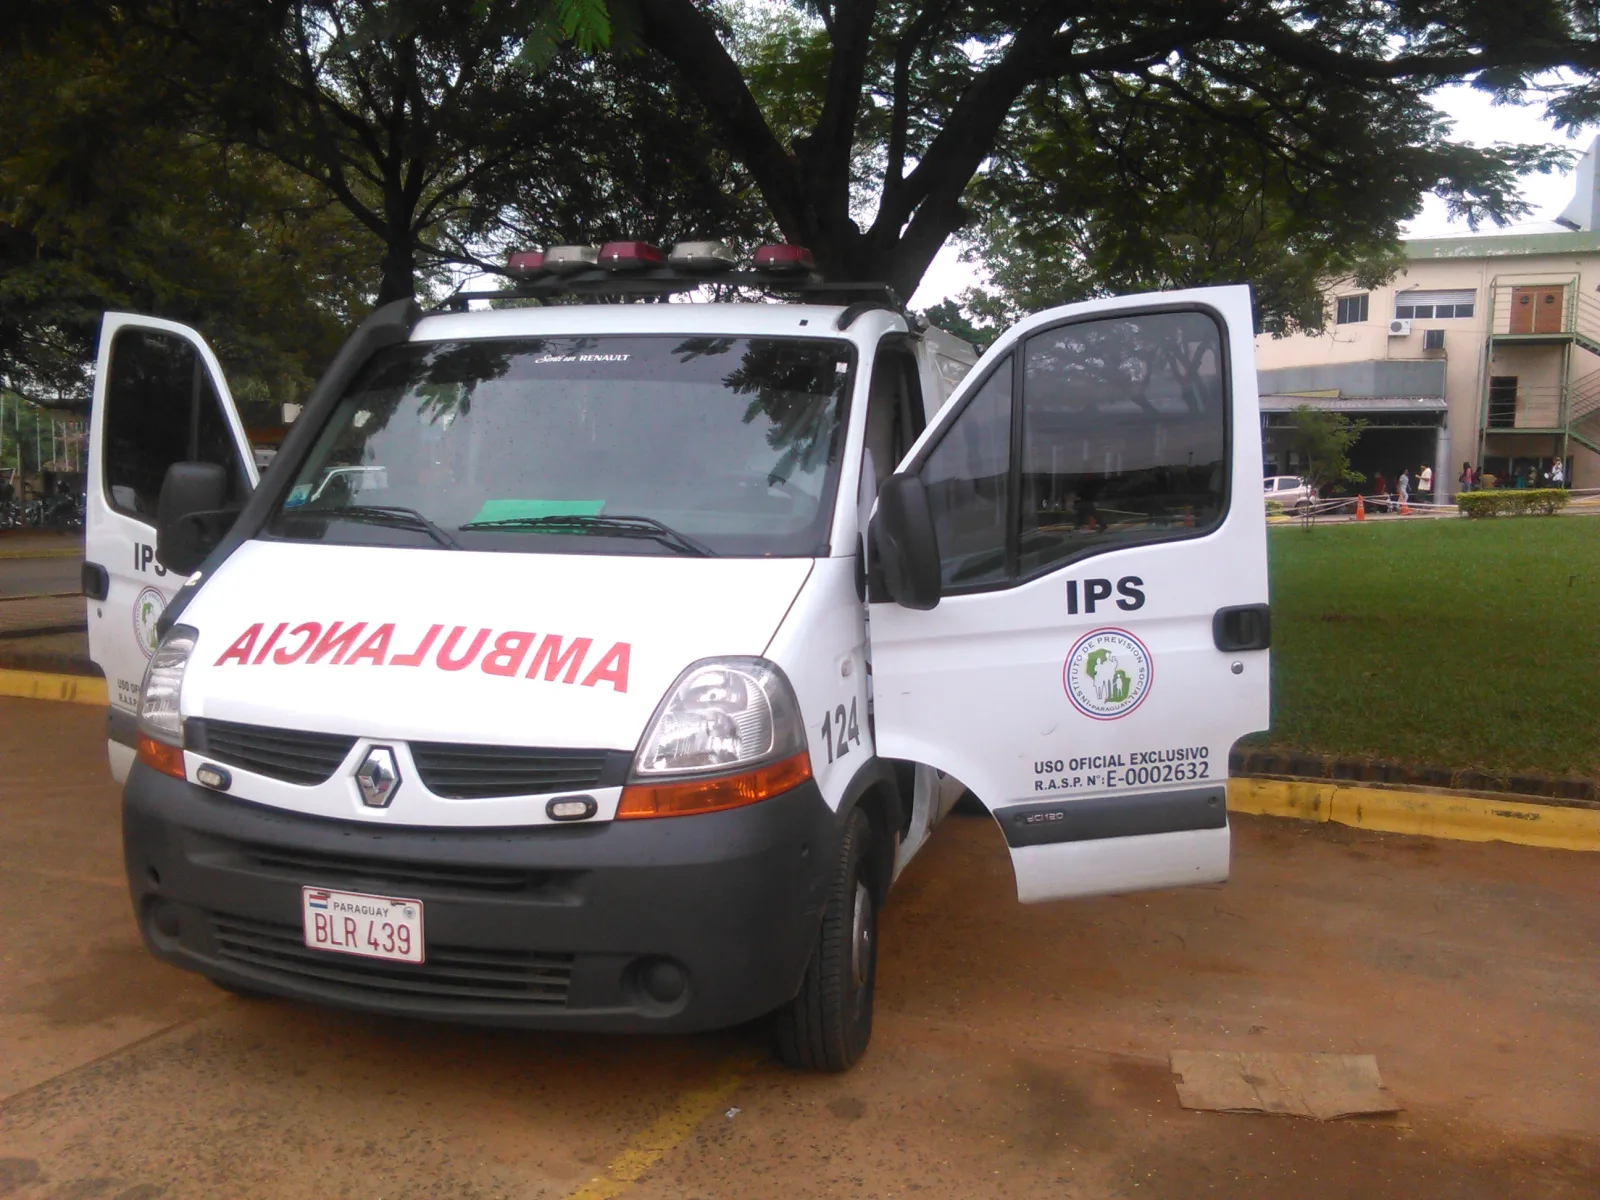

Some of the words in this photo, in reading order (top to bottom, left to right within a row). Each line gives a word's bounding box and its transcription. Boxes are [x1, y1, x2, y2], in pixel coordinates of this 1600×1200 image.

[579, 354, 631, 362] RENAULT
[1066, 575, 1146, 615] IPS
[1071, 655, 1090, 705] INSTITUTO
[1081, 641, 1095, 653] DE
[1097, 636, 1144, 664] PREVISION
[1128, 667, 1145, 700] SOCIAL
[1090, 701, 1129, 712] PARAGUAY
[821, 695, 861, 765] 124
[1034, 759, 1064, 775] USO
[1069, 754, 1125, 771] OFICIAL
[1129, 746, 1209, 765] EXCLUSIVO
[1034, 777, 1083, 791] R.A.S.P.
[1107, 761, 1210, 788] E-0002632
[333, 901, 389, 917] PARAGUAY
[314, 912, 358, 948] BLR
[367, 920, 411, 955] 439
